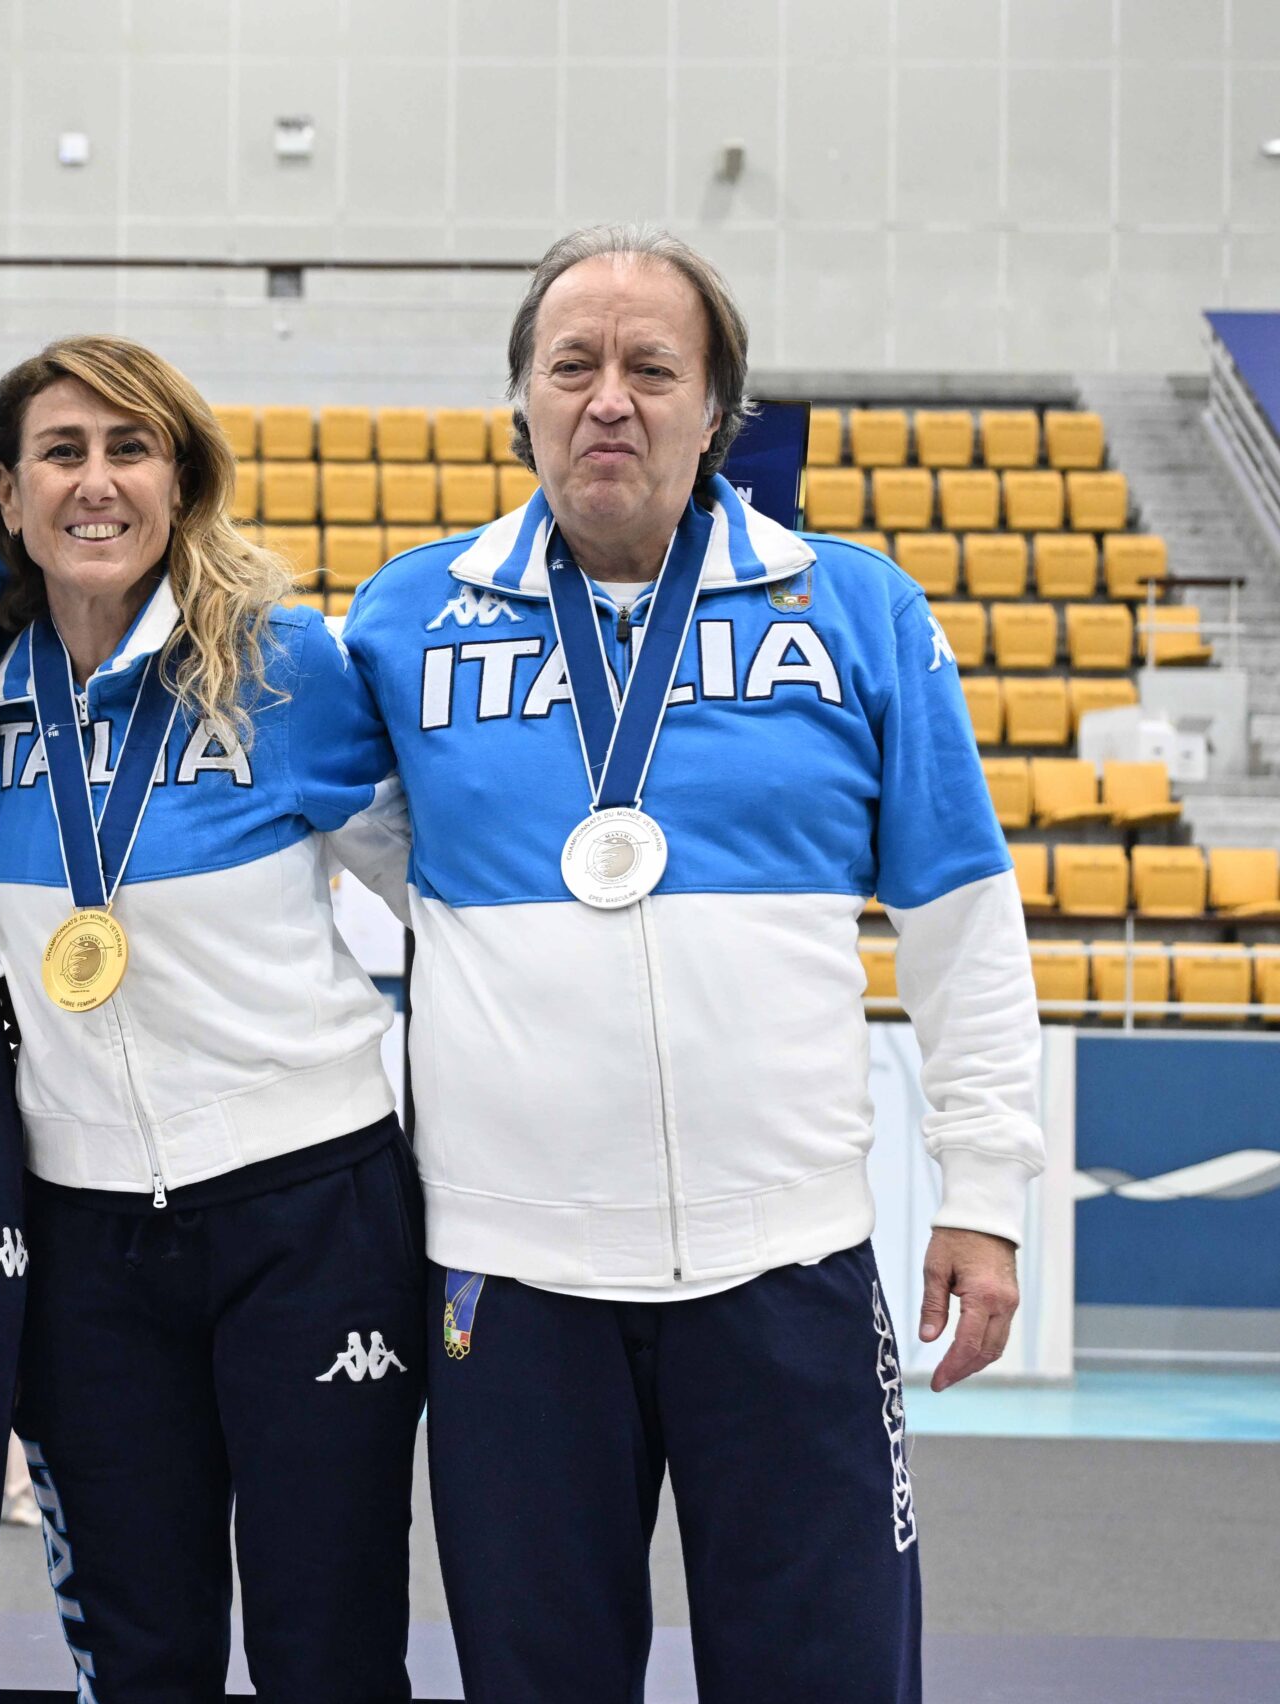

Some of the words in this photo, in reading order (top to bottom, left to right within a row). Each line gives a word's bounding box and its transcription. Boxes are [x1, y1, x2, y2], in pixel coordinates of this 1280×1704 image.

[48, 730, 60, 738] FIE
[566, 816, 602, 861] CHAMPIONNATS
[603, 811, 614, 819] DU
[616, 810, 642, 821] MONDE
[45, 918, 78, 961] CHAMPIONNATS
[90, 913, 110, 924] MONDE
[59, 997, 75, 1008] SABRE
[76, 997, 97, 1008] FEMININ
